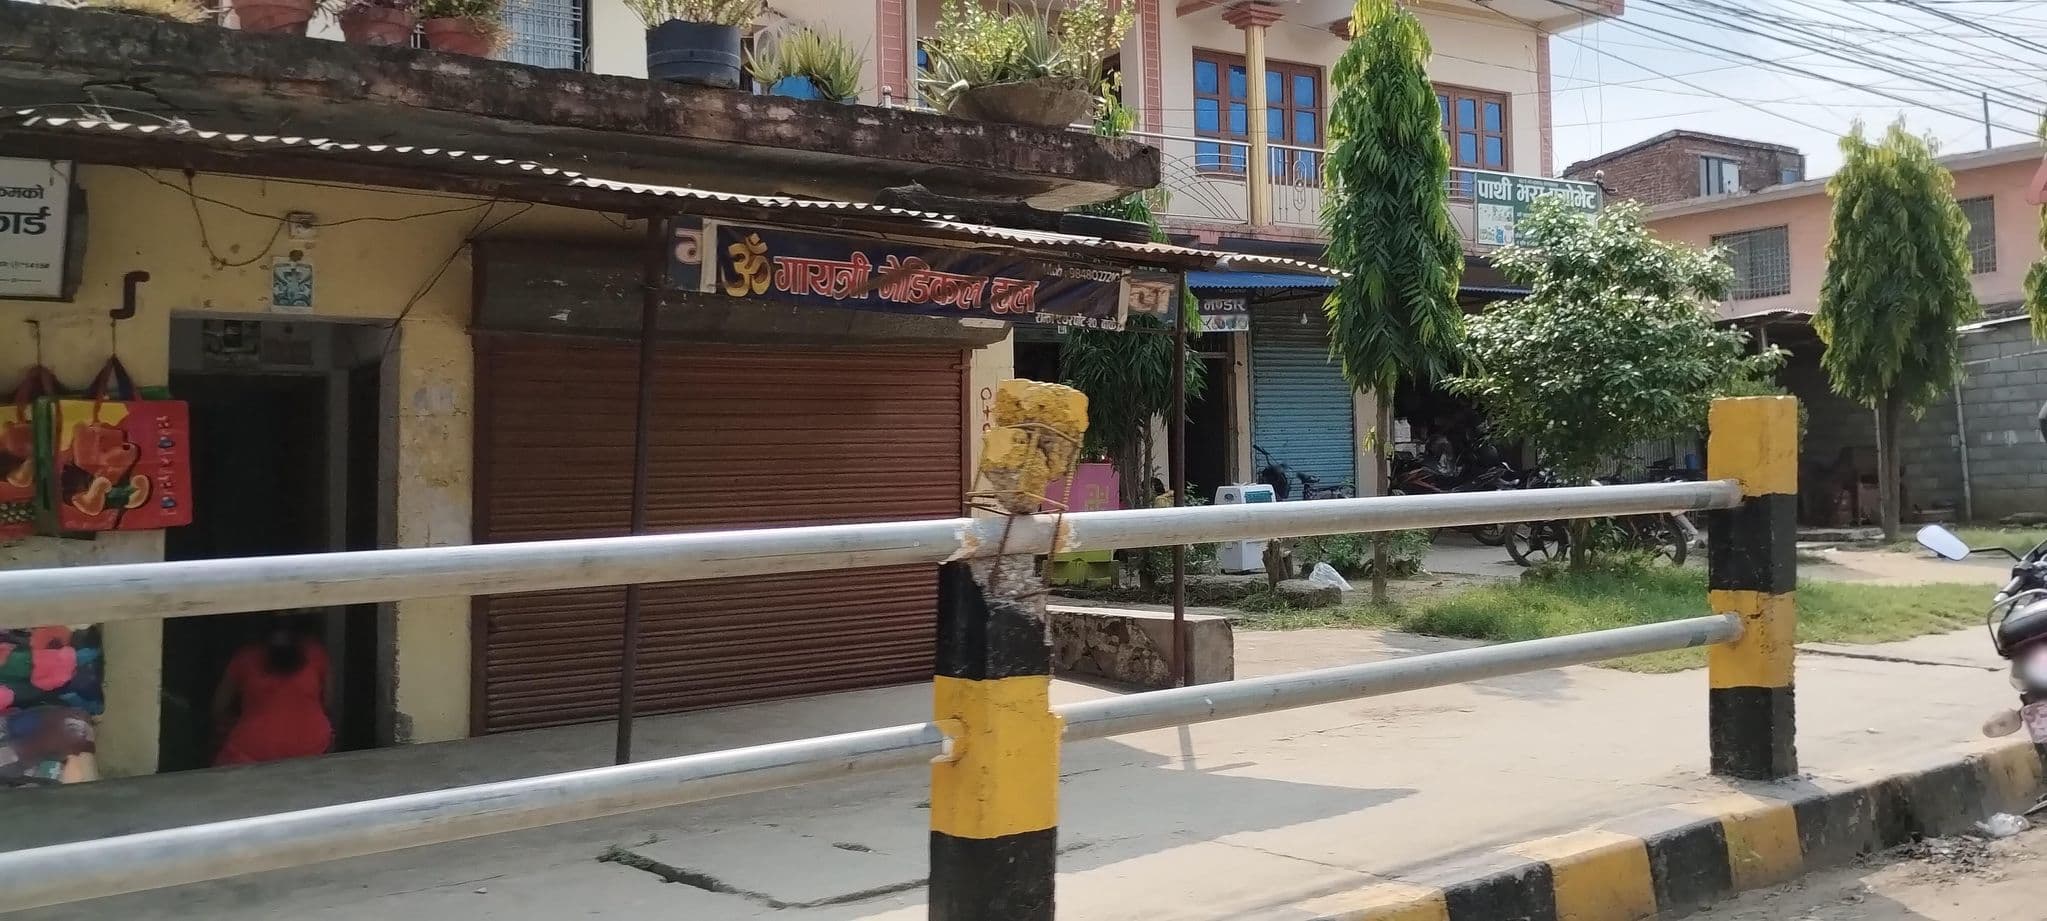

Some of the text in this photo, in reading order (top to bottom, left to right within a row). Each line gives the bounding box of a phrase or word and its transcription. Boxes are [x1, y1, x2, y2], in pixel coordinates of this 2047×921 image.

[1477, 176, 1513, 201] पाथी
[773, 250, 873, 300] गायत्री
[878, 254, 990, 310] मेडिकल
